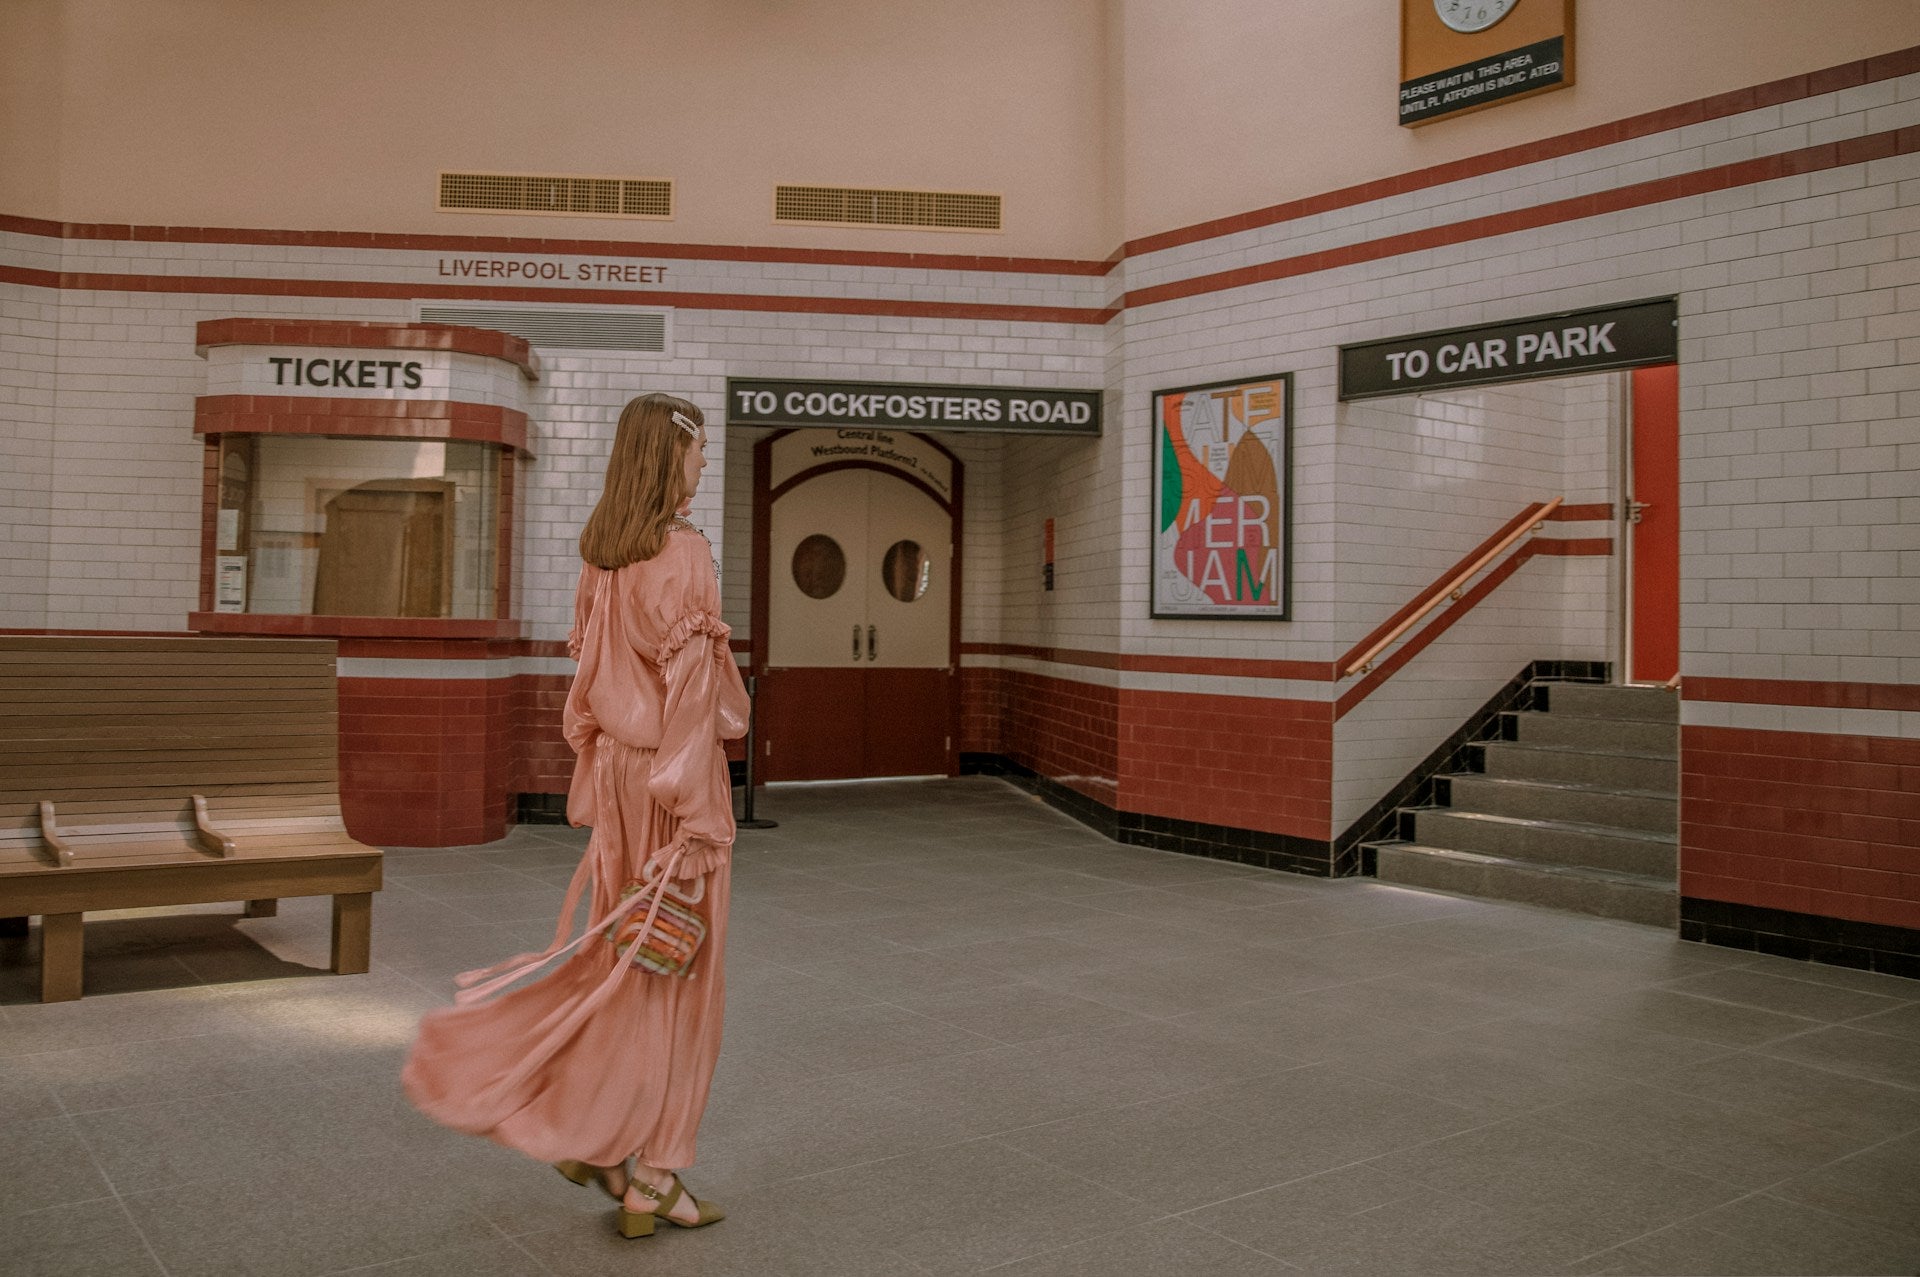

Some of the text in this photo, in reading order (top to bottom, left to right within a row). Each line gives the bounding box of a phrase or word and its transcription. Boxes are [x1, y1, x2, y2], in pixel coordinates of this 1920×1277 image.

[1401, 54, 1533, 100] PLEASE WAIT IN THIS AREA
[1401, 99, 1427, 115] UNTIL
[1485, 79, 1497, 92] IS
[438, 258, 668, 284] LIVERPOOL STREET
[1385, 321, 1617, 381] TO CAR PARK
[268, 357, 424, 390] TICKETS
[735, 389, 1092, 425] TO COCKFOSTERS ROAD
[811, 444, 869, 457] Westbound
